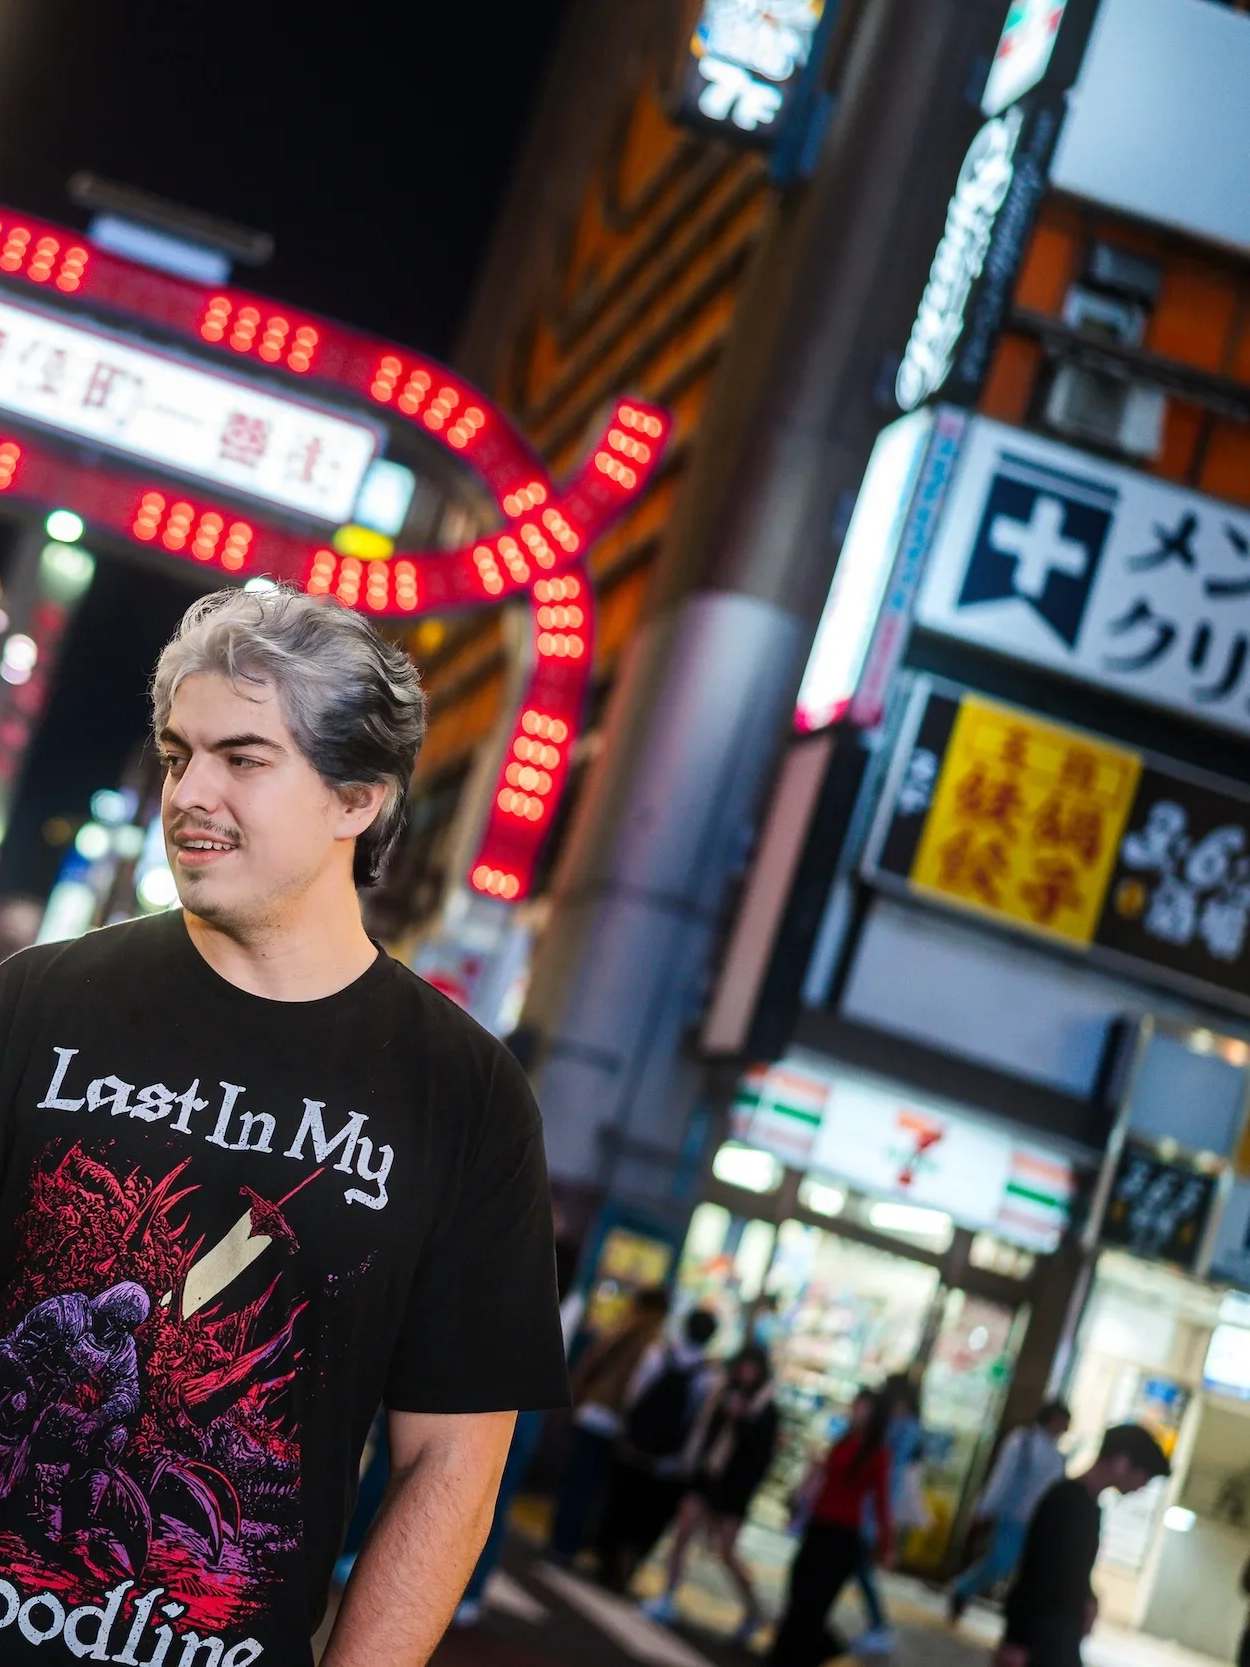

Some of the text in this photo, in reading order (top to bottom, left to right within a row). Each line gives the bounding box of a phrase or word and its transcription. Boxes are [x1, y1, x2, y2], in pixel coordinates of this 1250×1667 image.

[37, 1046, 395, 1211] Last In My
